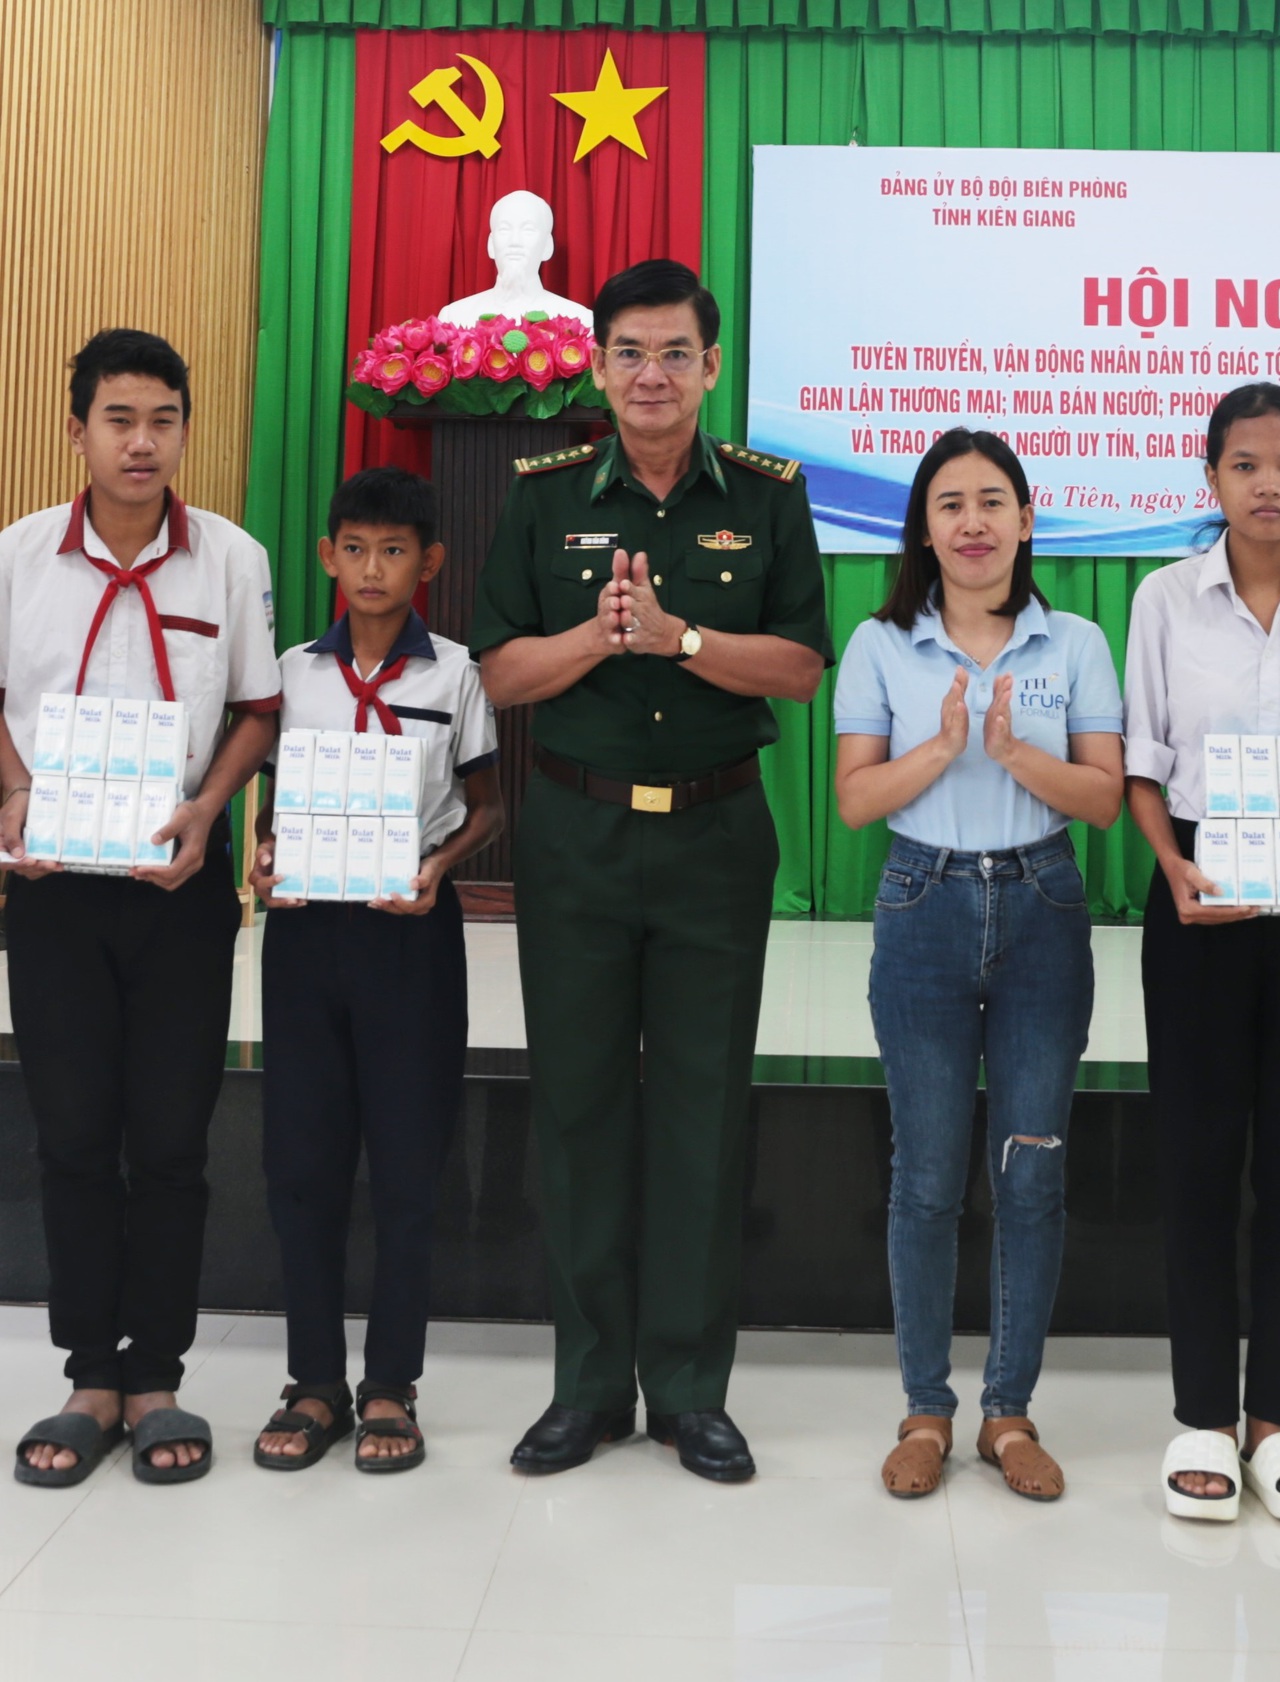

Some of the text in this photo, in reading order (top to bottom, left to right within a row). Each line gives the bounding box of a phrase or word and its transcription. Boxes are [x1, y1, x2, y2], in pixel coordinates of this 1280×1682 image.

[881, 171, 1127, 201] ĐẢNG ỦY BỘ ĐỘI BIÊN PHÒNG
[933, 201, 1075, 228] TỈNH KIÊN GIANG
[1083, 266, 1188, 338] HỘI
[851, 341, 907, 371] TUYÊN
[913, 339, 988, 375] TRUYỀN,
[994, 343, 1029, 376] VẬN
[1035, 344, 1084, 378] ĐỘNG
[1091, 344, 1141, 374] NHÂN
[1147, 345, 1183, 375] DÂN
[1190, 341, 1211, 375] TỐ
[1217, 345, 1260, 378] GIÁC
[800, 386, 842, 411] GIAN
[849, 382, 883, 417] LẬN
[890, 387, 960, 413] THƯƠNG
[967, 388, 1007, 419] MẠI;
[1013, 390, 1054, 415] MUA
[1060, 385, 1096, 415] BÁN
[1103, 388, 1164, 419] NGƯỜI;
[1169, 384, 1228, 417] PHÒN
[852, 426, 875, 453] VÀ
[880, 430, 924, 454] TRAO
[1016, 428, 1071, 457] NGƯỜI
[1077, 433, 1099, 457] UY
[1106, 429, 1140, 460] TÍN,
[1146, 434, 1176, 457] GIA
[1065, 482, 1121, 510] Tiên,
[1131, 487, 1186, 514] ngày
[1020, 677, 1047, 690] TH
[1019, 691, 1065, 710] true
